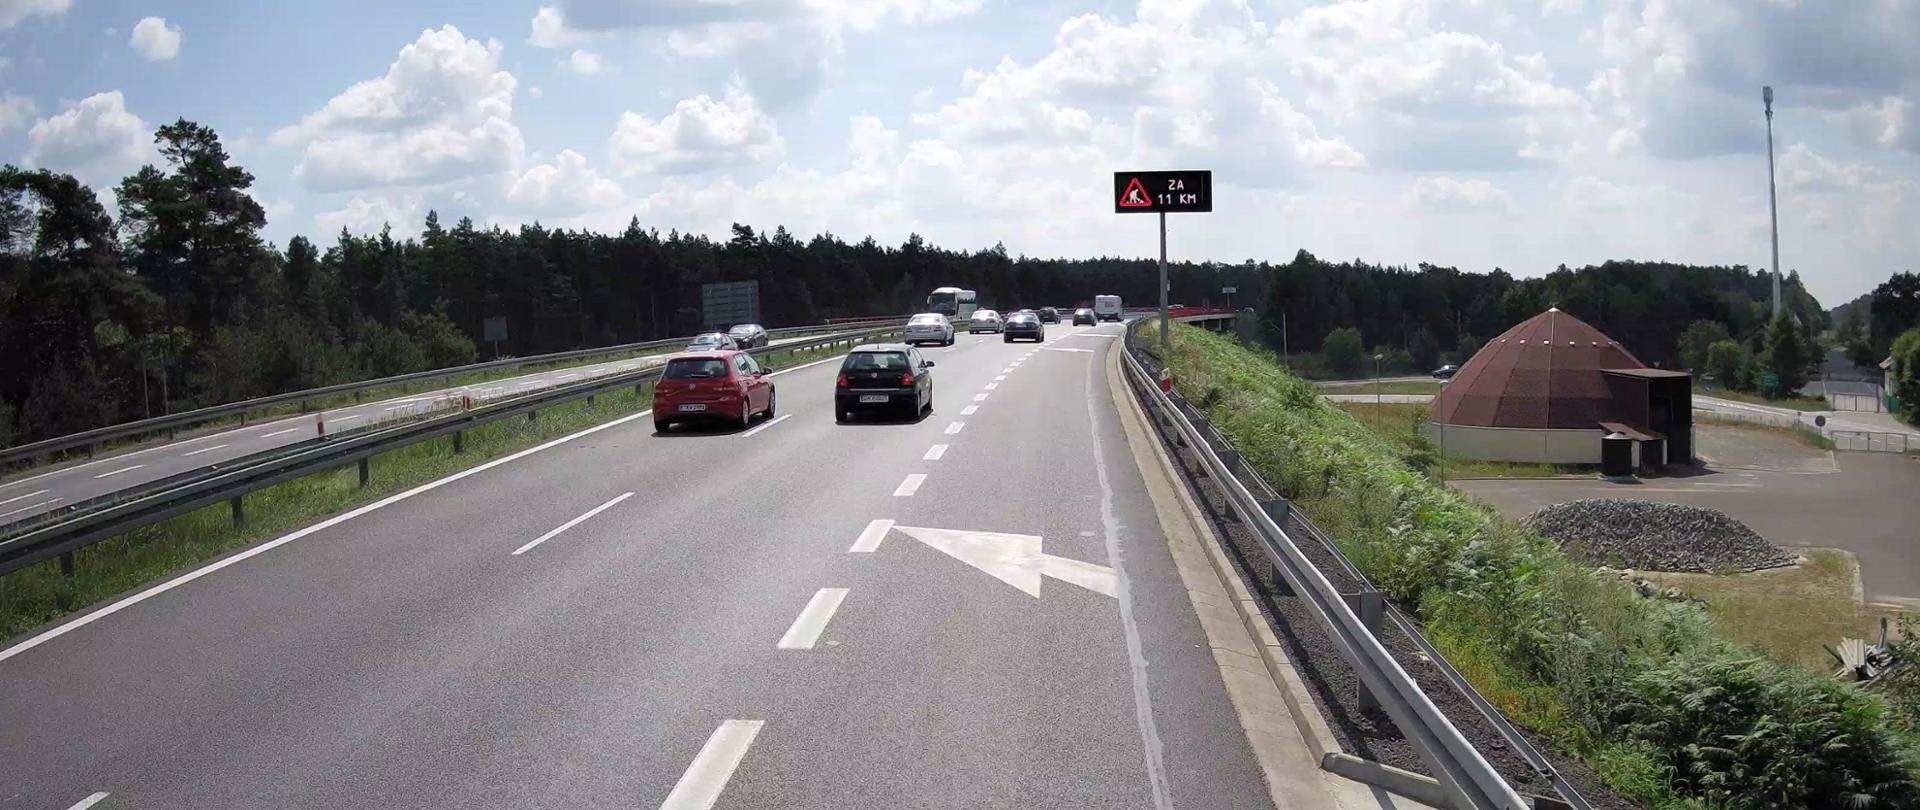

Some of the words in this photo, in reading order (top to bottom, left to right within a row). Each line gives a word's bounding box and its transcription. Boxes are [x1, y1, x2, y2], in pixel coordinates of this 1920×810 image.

[1168, 179, 1184, 190] ZA
[1158, 193, 1172, 204] 11
[1179, 193, 1196, 204] KM
